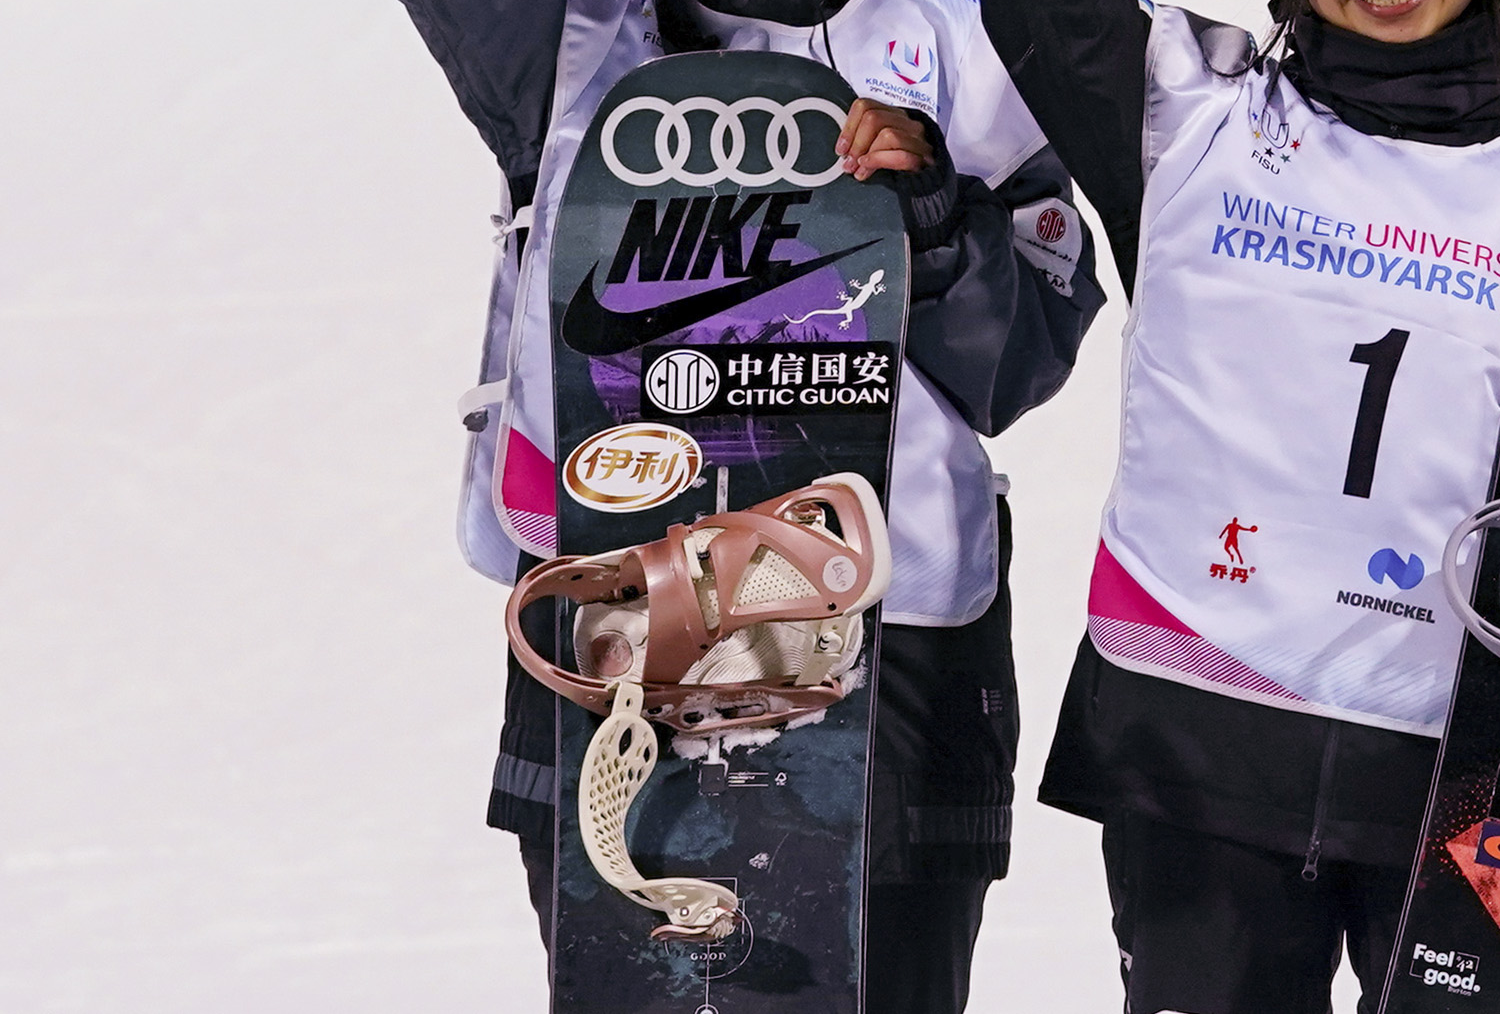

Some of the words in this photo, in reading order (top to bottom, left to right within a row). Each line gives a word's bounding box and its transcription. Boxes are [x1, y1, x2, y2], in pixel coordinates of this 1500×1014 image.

[1250, 150, 1281, 176] FISU
[1223, 191, 1356, 241] WINTER
[605, 189, 813, 285] NIKE
[1211, 224, 1499, 312] KRASNOYARSK
[727, 351, 890, 386] 中信国安
[727, 387, 795, 406] CITIC
[799, 387, 890, 405] GUOAN
[1342, 328, 1411, 499] 1
[583, 447, 680, 485] 伊利
[1209, 563, 1249, 584] 乔丹
[1335, 590, 1435, 624] NORNICKEL
[690, 952, 727, 961] GOOD
[1413, 942, 1455, 968] Feel
[1423, 968, 1481, 993] good.
